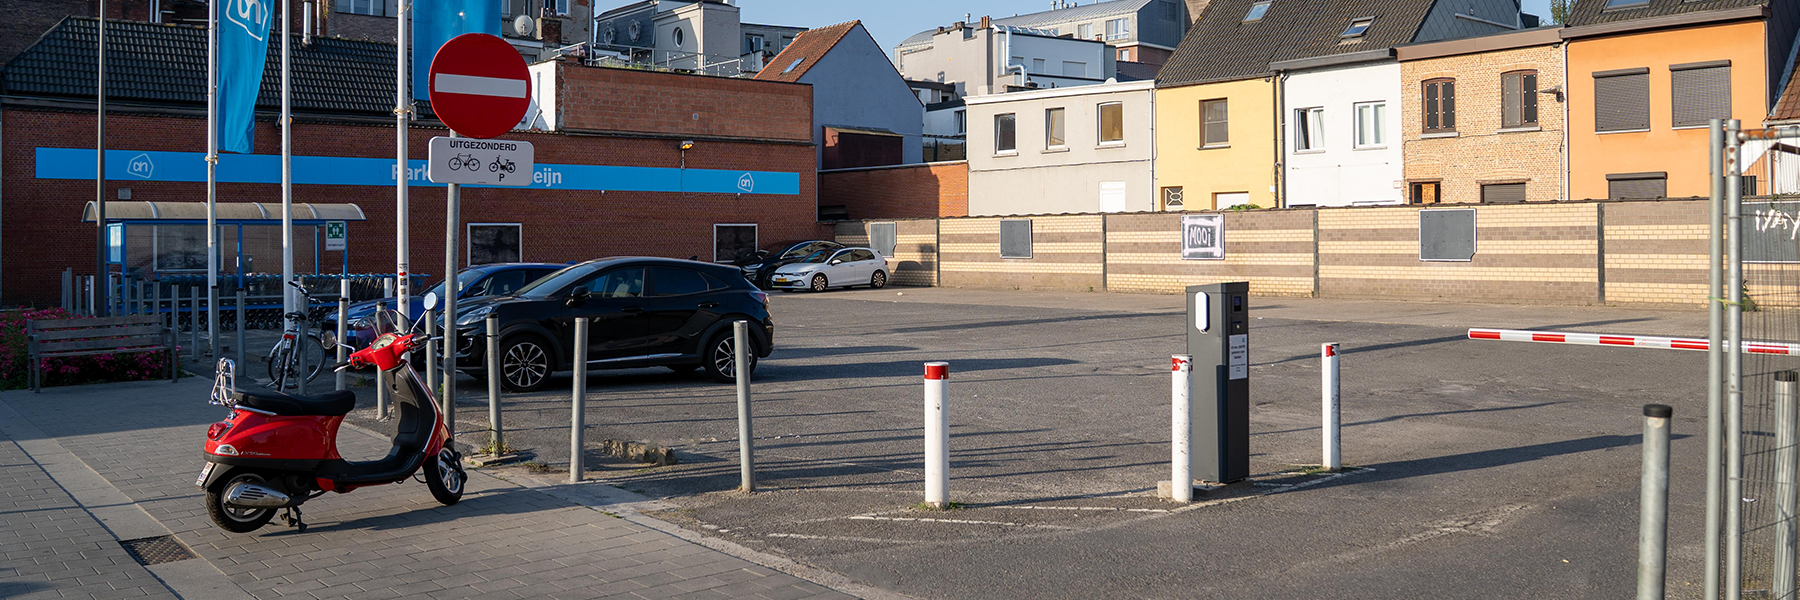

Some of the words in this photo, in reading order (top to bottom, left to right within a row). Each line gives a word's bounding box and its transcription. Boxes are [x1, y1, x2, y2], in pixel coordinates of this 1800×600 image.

[449, 140, 517, 151] UITGEZONDERD
[498, 173, 505, 182] P
[532, 167, 562, 187] eijn
